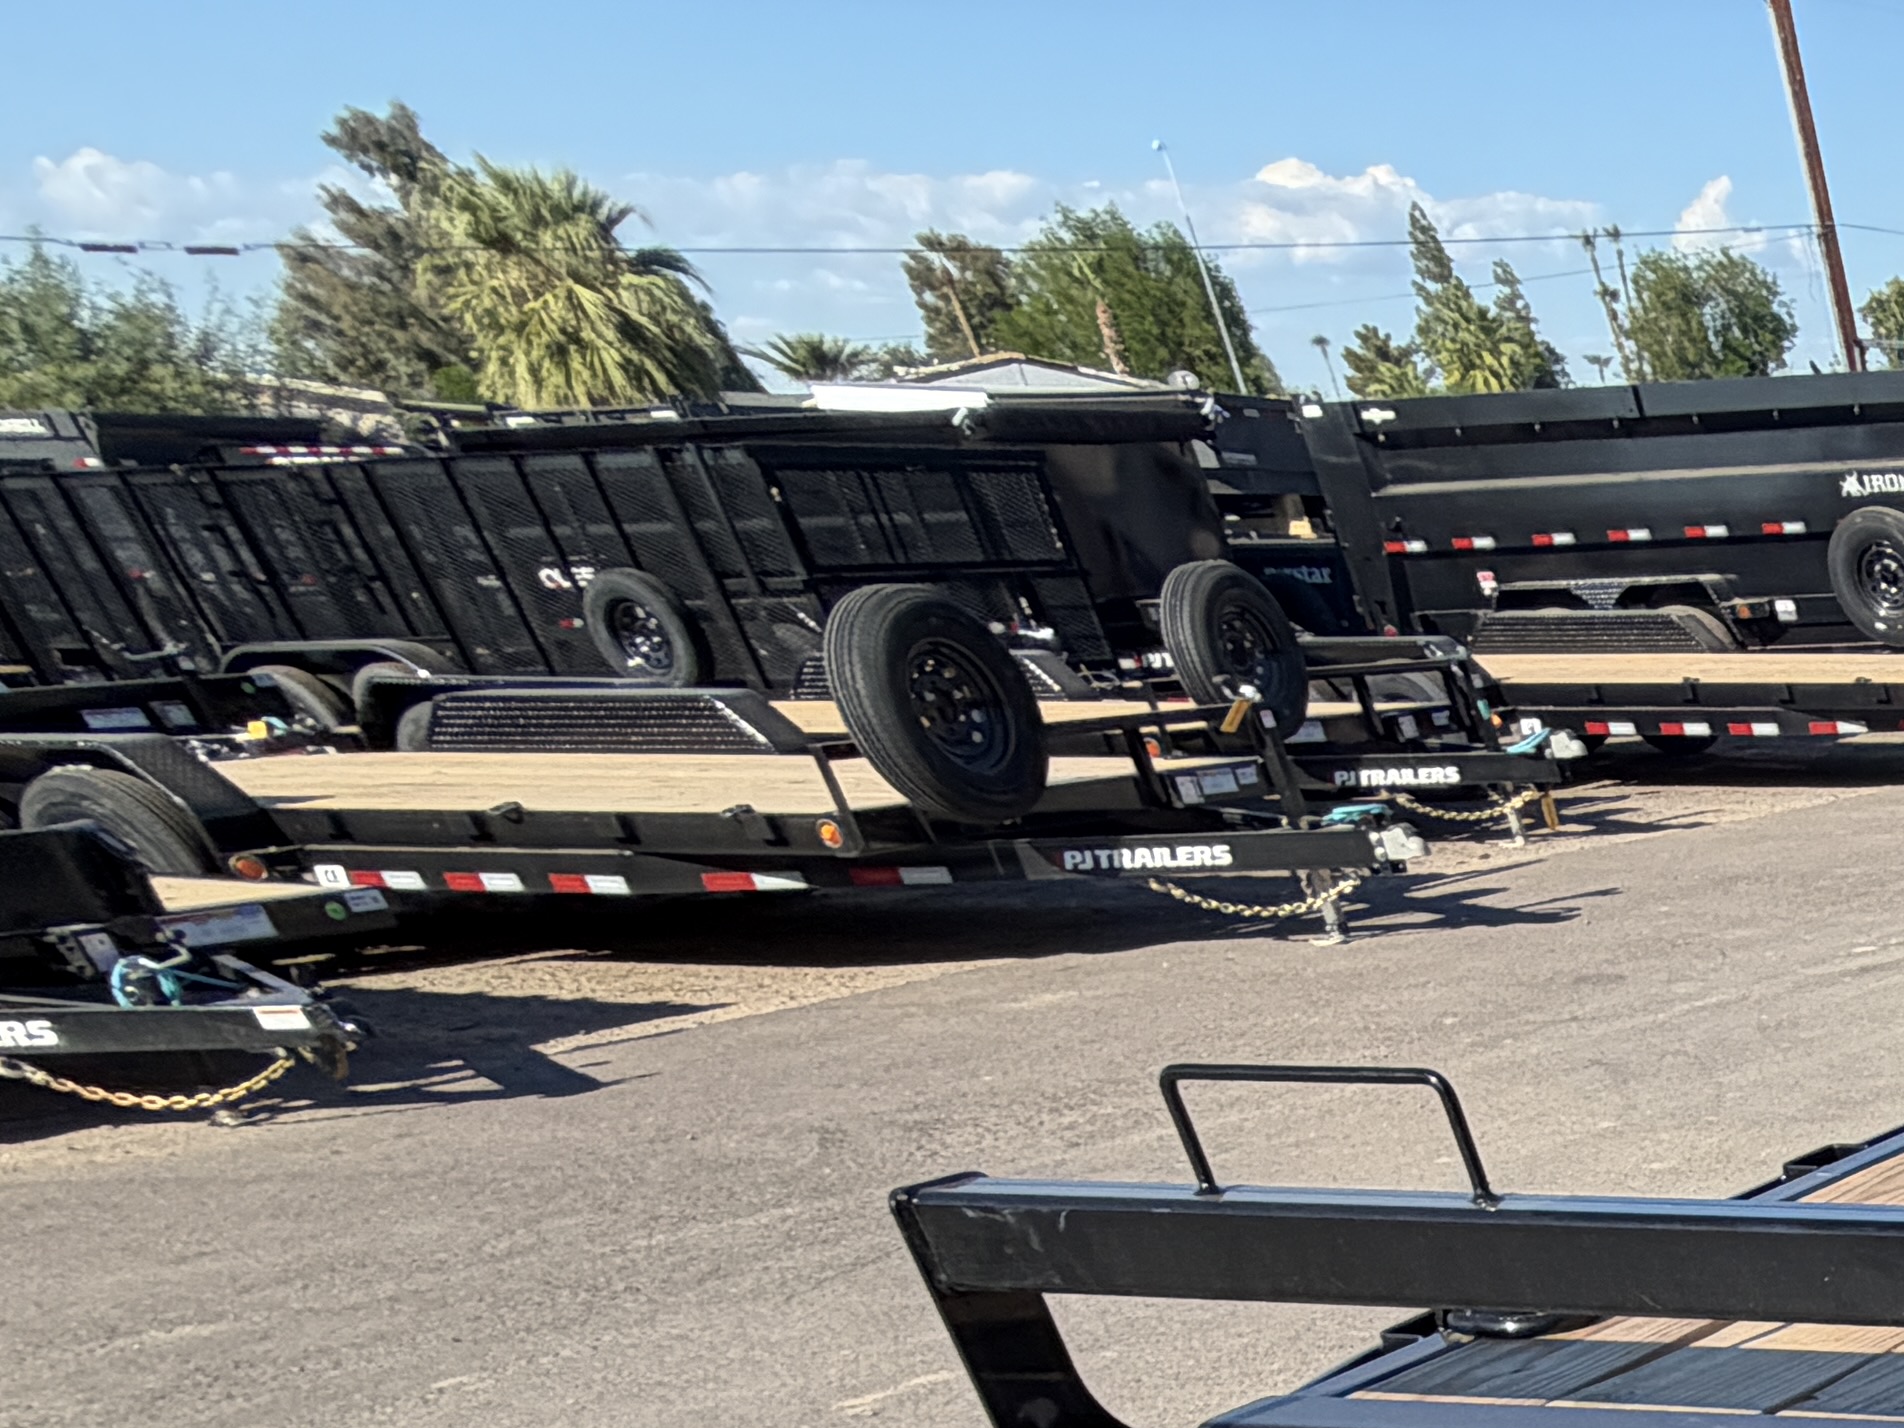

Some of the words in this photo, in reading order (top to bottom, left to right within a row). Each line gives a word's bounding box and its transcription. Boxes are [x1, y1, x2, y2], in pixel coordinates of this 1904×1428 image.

[1334, 770, 1357, 786] PJ
[1360, 766, 1461, 787] TRAILERS
[1063, 850, 1093, 870] PJ
[1094, 845, 1233, 869] TRAILERS
